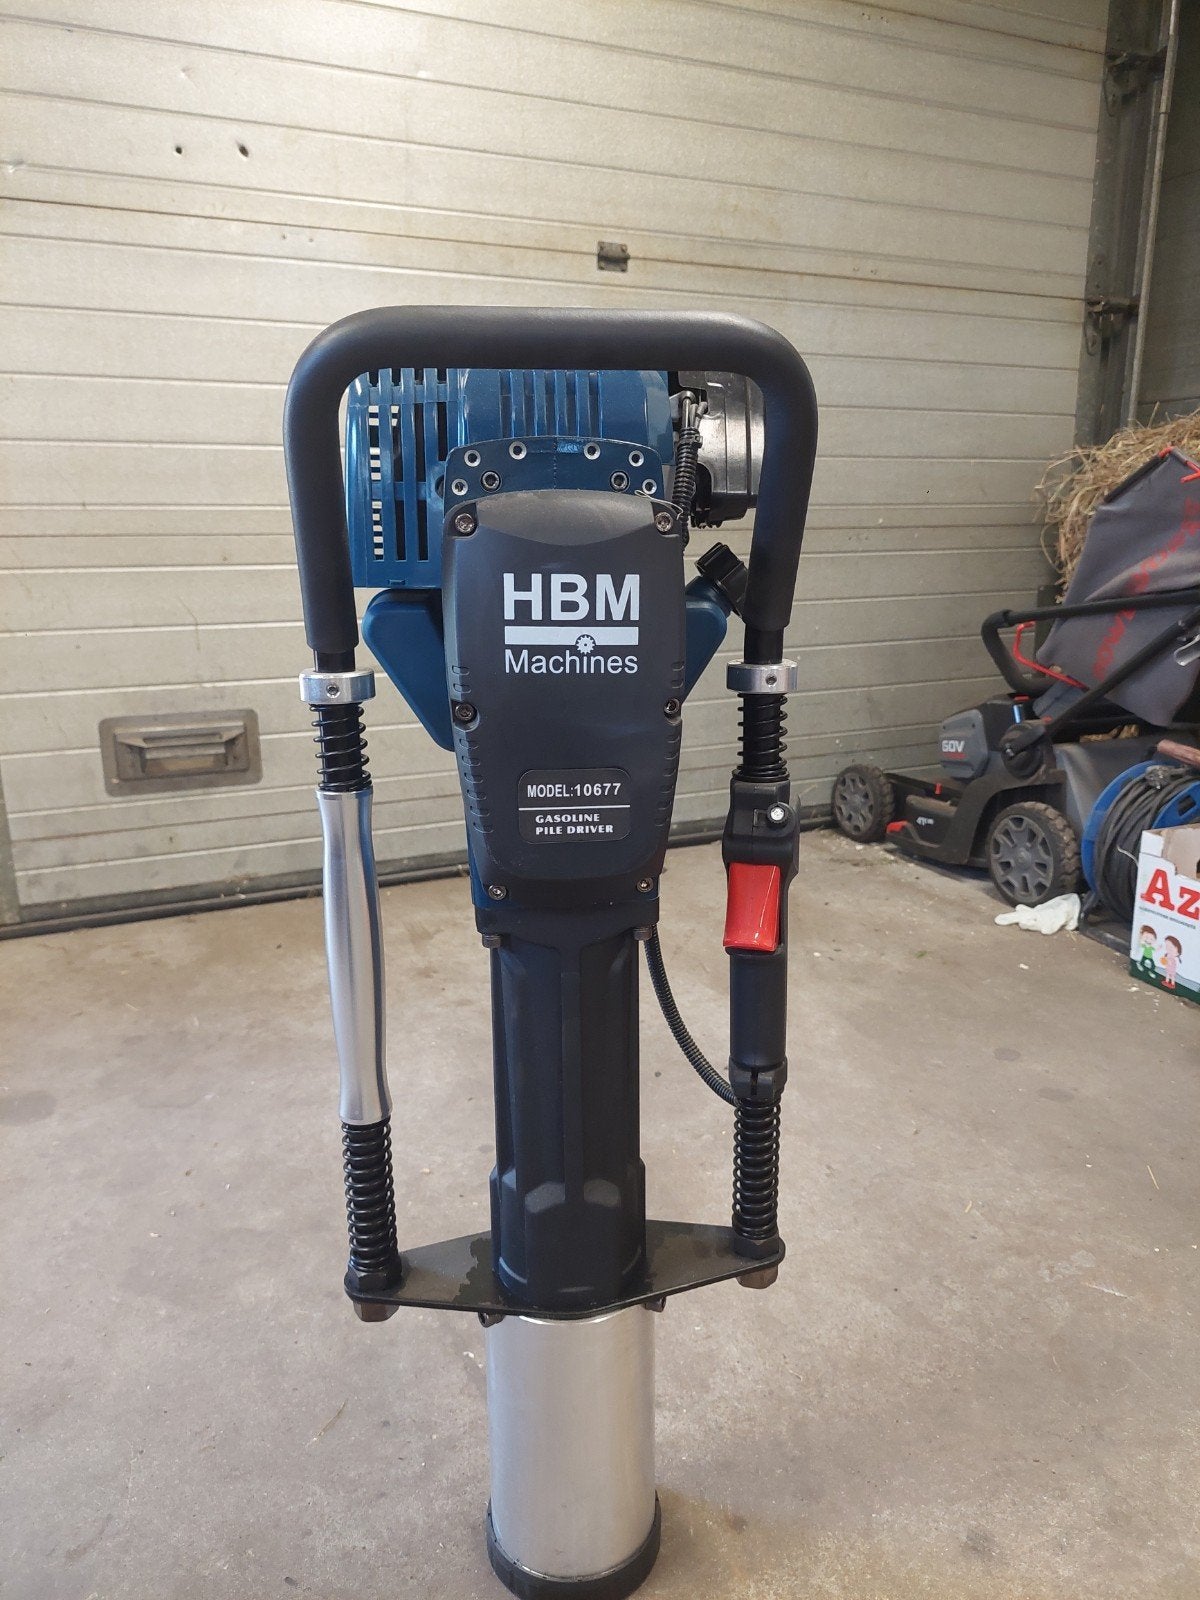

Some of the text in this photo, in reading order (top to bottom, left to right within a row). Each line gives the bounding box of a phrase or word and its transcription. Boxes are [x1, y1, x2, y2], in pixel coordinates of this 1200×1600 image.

[503, 573, 640, 621] HBM
[505, 649, 638, 674] Machines
[942, 740, 965, 753] 60V
[535, 813, 600, 824] GASOLINE
[535, 825, 614, 835] PILE DRIVER
